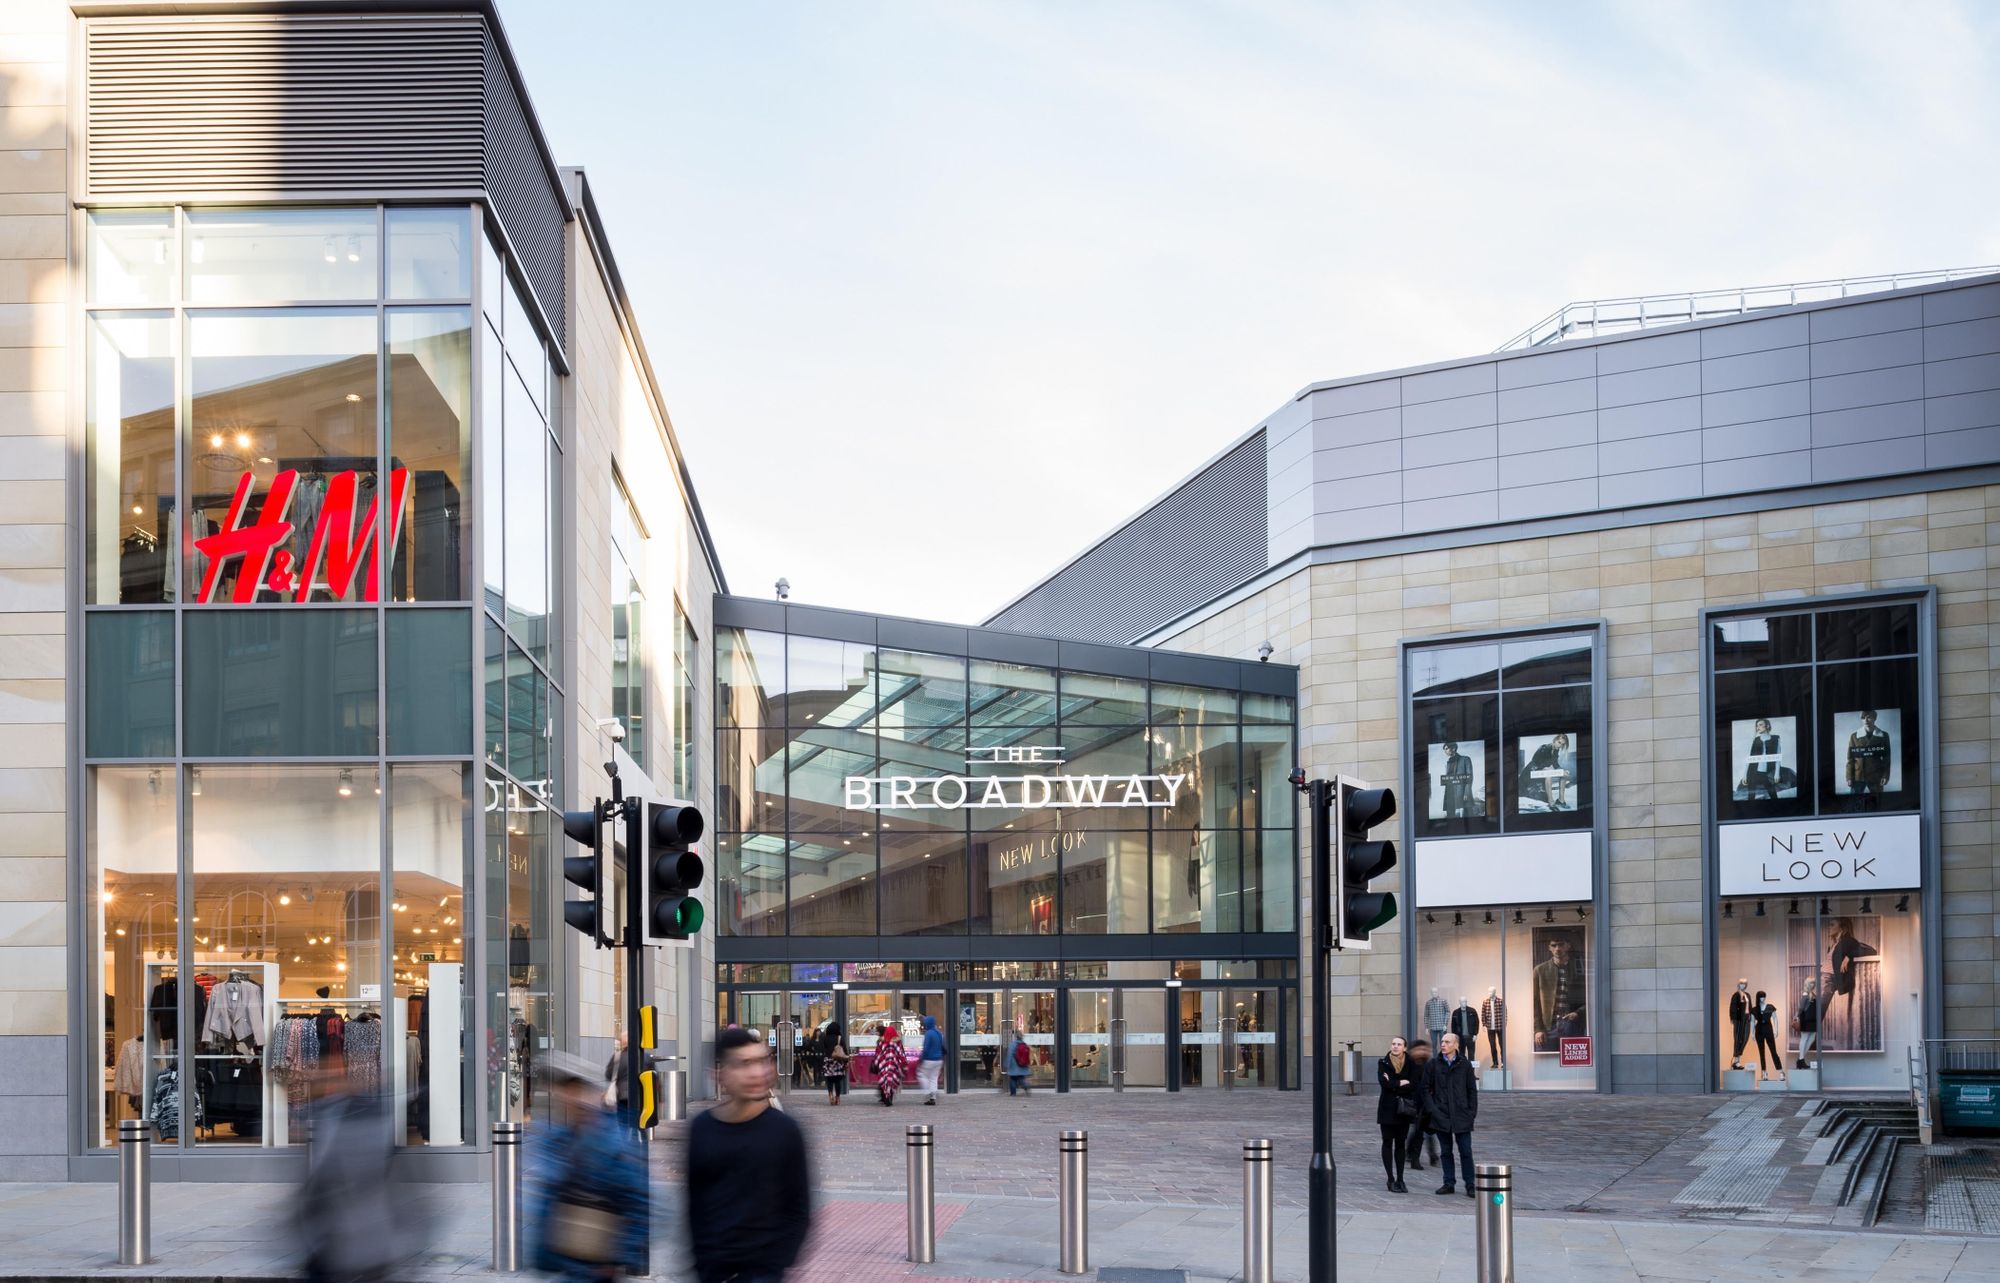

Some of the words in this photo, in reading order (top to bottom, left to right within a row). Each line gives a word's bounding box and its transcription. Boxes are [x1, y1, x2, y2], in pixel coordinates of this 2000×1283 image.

[194, 468, 410, 604] H&M
[993, 746, 1043, 763] THE
[844, 773, 1186, 810] BROADWAY
[1770, 831, 1866, 854] NEW
[1000, 842, 1033, 871] NEW
[1762, 857, 1876, 881] LOOK
